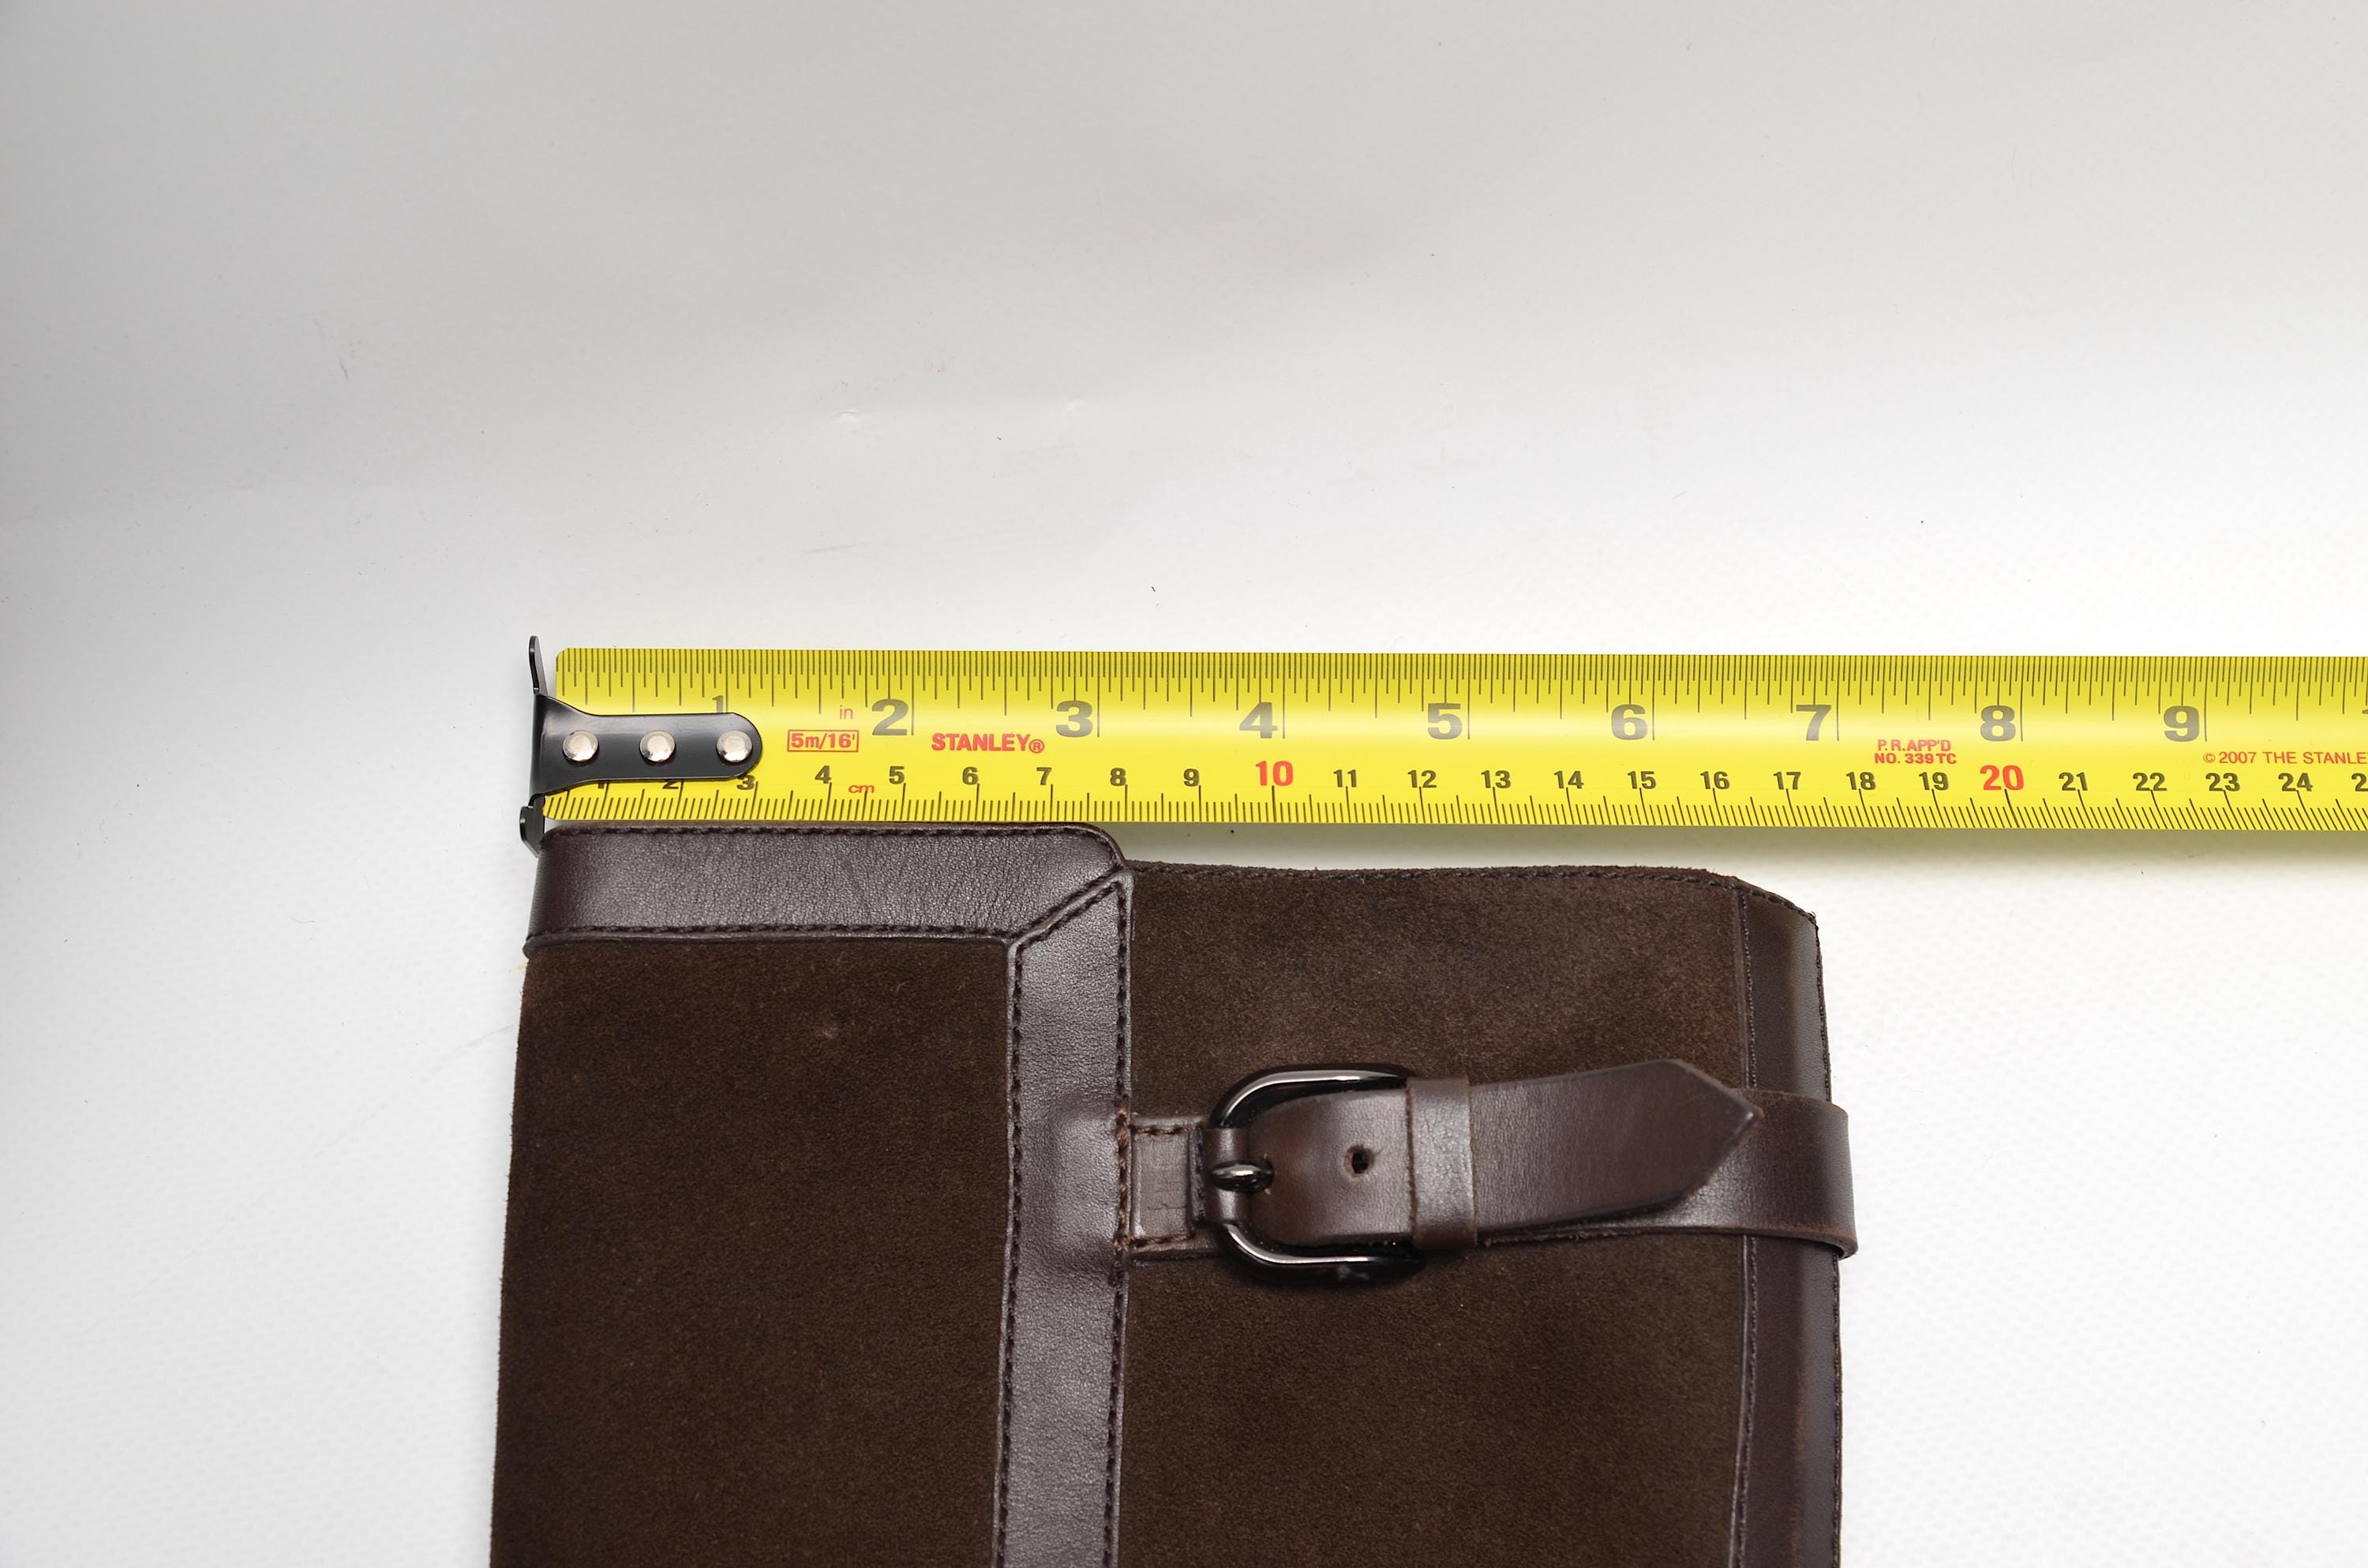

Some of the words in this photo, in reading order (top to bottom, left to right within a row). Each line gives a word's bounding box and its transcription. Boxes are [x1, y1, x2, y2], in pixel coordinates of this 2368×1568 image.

[840, 705, 852, 719] in
[871, 698, 908, 735] 2
[1055, 701, 1092, 738] 3
[1239, 702, 1278, 739] 4
[1428, 703, 1463, 740] 5
[1612, 705, 1648, 740] 6
[1796, 705, 1831, 741] 7
[1980, 705, 2016, 742] 8
[2164, 705, 2200, 742] 9
[1875, 753, 1900, 763] NO.
[2219, 751, 2257, 764] 2007
[2262, 752, 2297, 764] THE
[2303, 752, 2368, 764] STANLE
[736, 775, 755, 790] 3
[815, 765, 831, 784] 4
[890, 766, 905, 784] 5
[962, 767, 979, 785] 6
[1036, 767, 1051, 785] 7
[1111, 768, 1126, 786] 8
[1184, 769, 1200, 786] 9
[1256, 761, 1293, 785] 10
[1334, 769, 1357, 787] 11
[1408, 770, 1437, 788] 12
[1481, 770, 1511, 789] 13
[1554, 771, 1583, 789] 14
[1628, 771, 1656, 789] 15
[1700, 771, 1729, 789] 16
[1773, 772, 1801, 789] 17
[1846, 772, 1875, 790] 18
[1919, 772, 1949, 791] 19
[1980, 765, 2024, 791] 20
[2059, 773, 2088, 791] 21
[2133, 773, 2167, 791] 22
[2205, 773, 2240, 791] 23
[2278, 773, 2313, 791] 24
[2351, 773, 2368, 791] 2
[849, 784, 875, 793] cm
